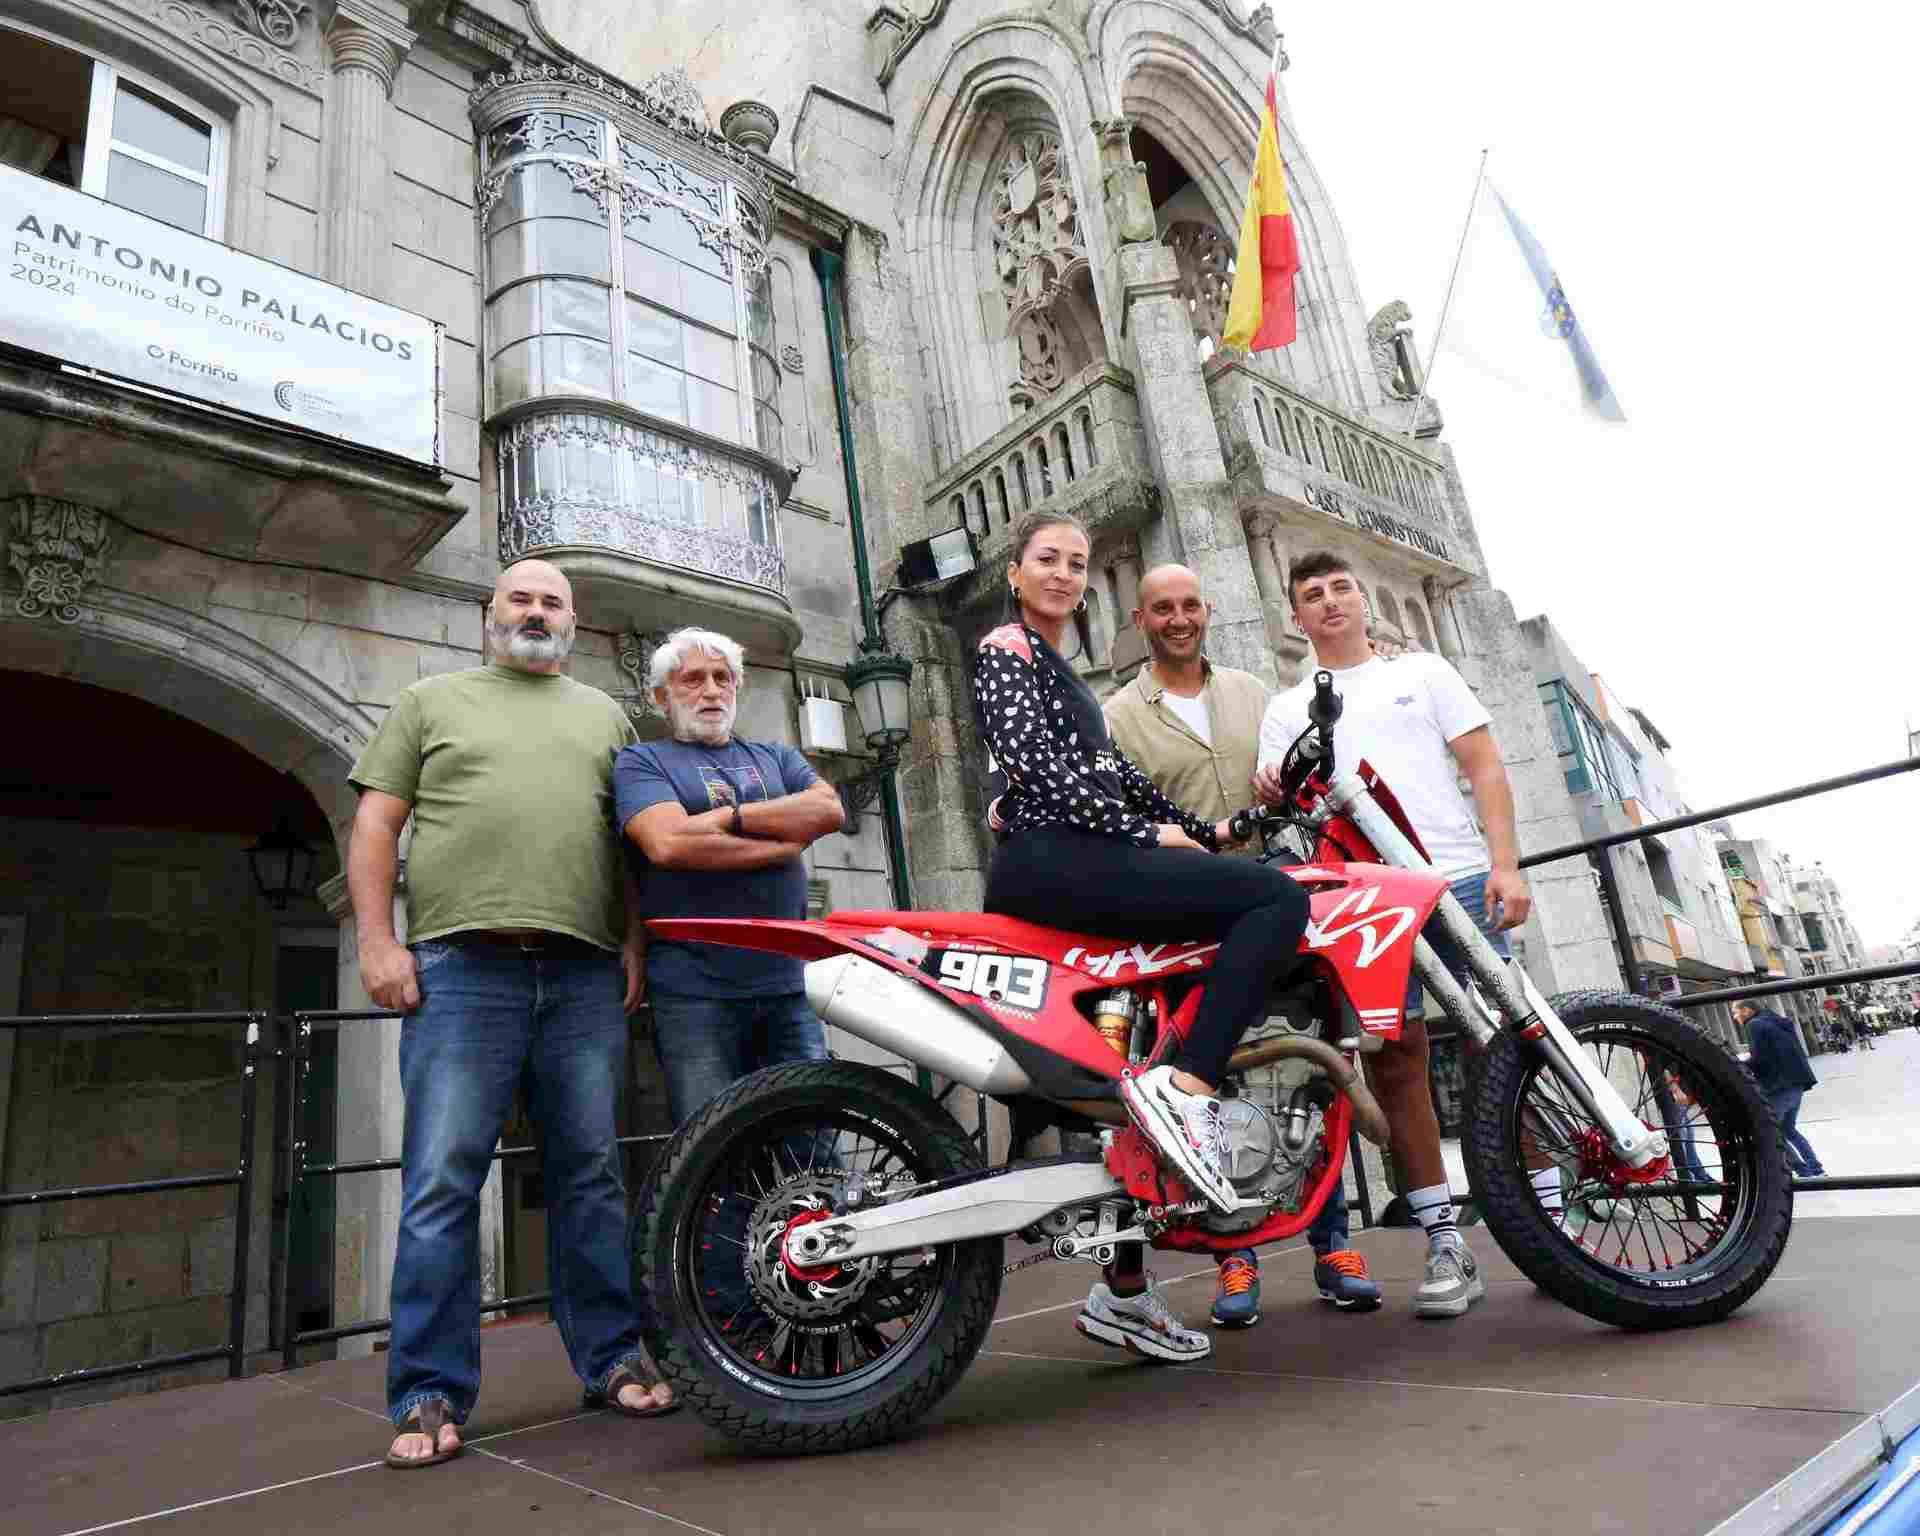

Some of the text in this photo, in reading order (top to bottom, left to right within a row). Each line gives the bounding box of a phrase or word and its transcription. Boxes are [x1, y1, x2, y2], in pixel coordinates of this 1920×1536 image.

[10, 263, 76, 297] 2024
[14, 241, 285, 343] Patrimonio do Porriño
[16, 215, 413, 361] ANTONIO PALACIOS
[169, 350, 239, 382] Porriño
[938, 950, 1048, 1010] 903
[871, 1118, 900, 1138] EXCEL
